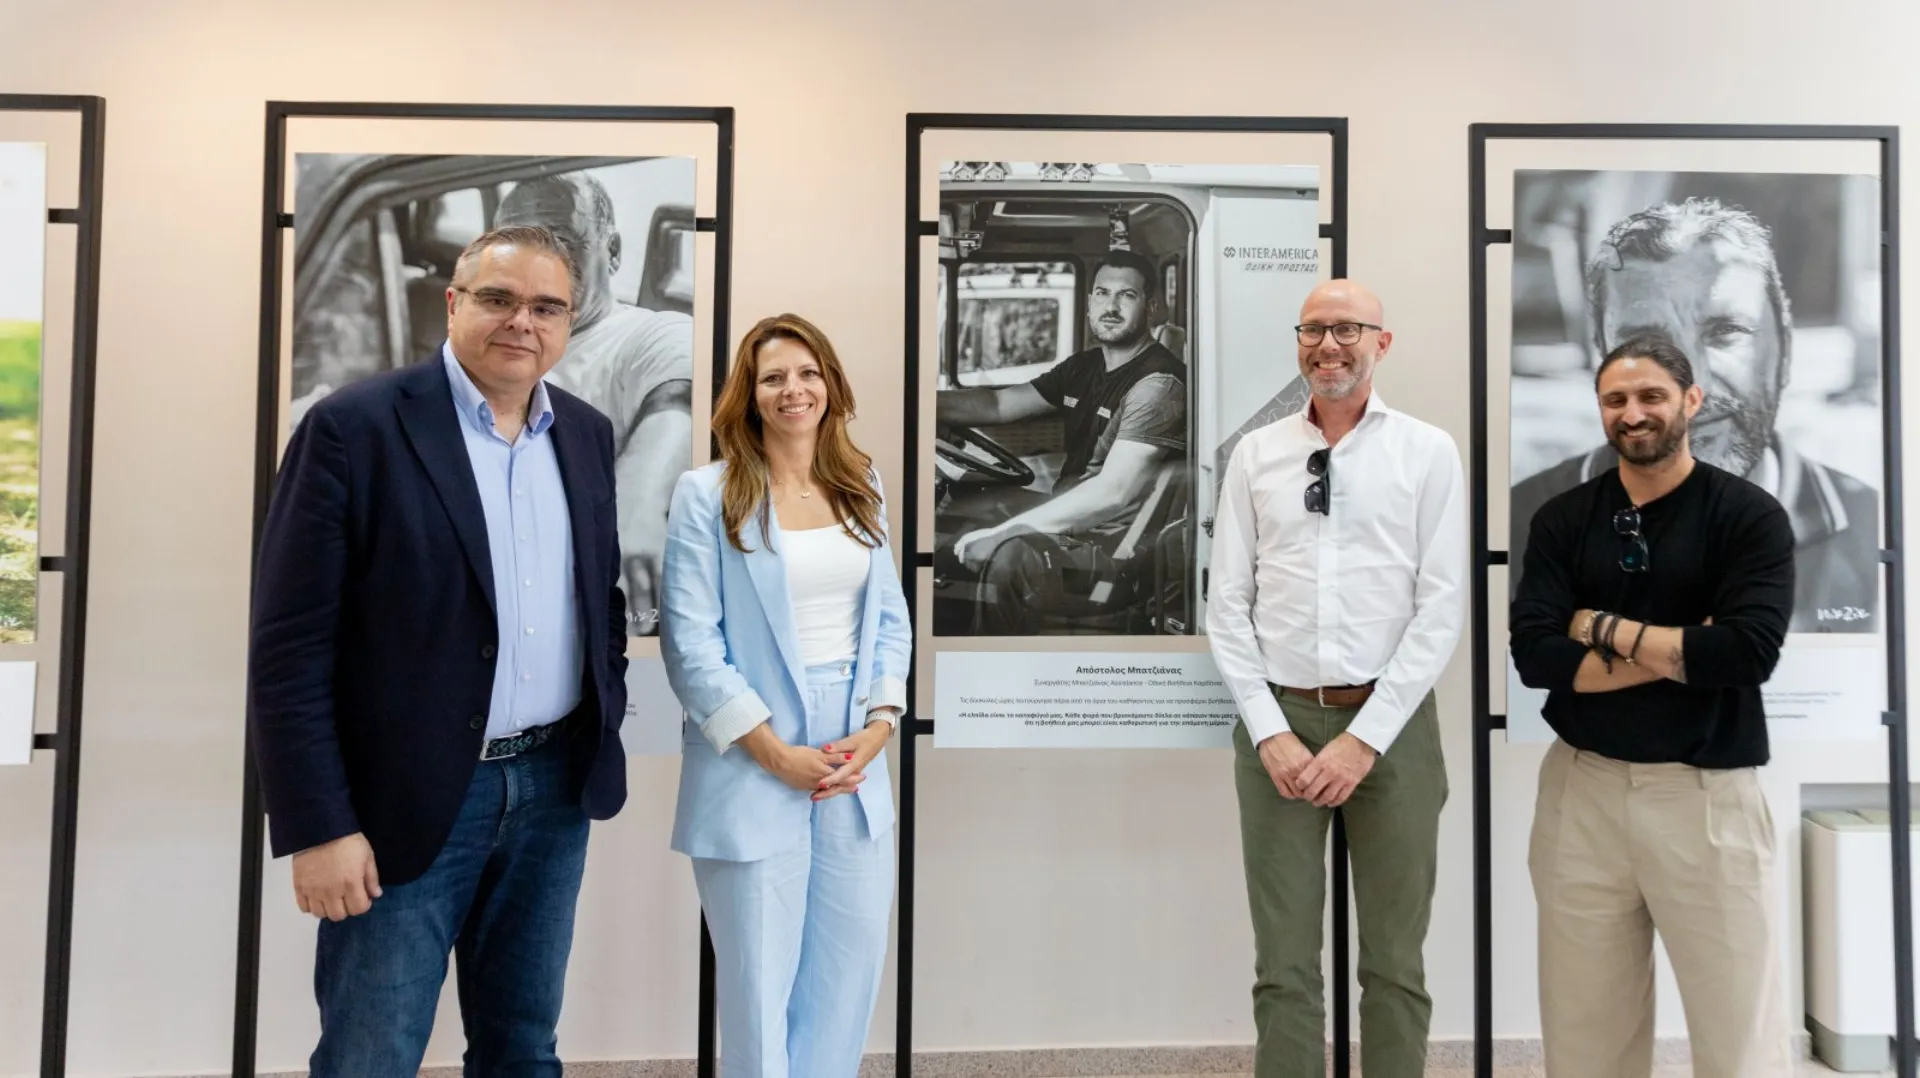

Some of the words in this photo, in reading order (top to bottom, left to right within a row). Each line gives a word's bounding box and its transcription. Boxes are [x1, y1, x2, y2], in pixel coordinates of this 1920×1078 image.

[1239, 247, 1319, 260] INTERAMERICA
[1076, 665, 1126, 675] Απόστολος
[1127, 665, 1182, 675] Μπατζιάνας
